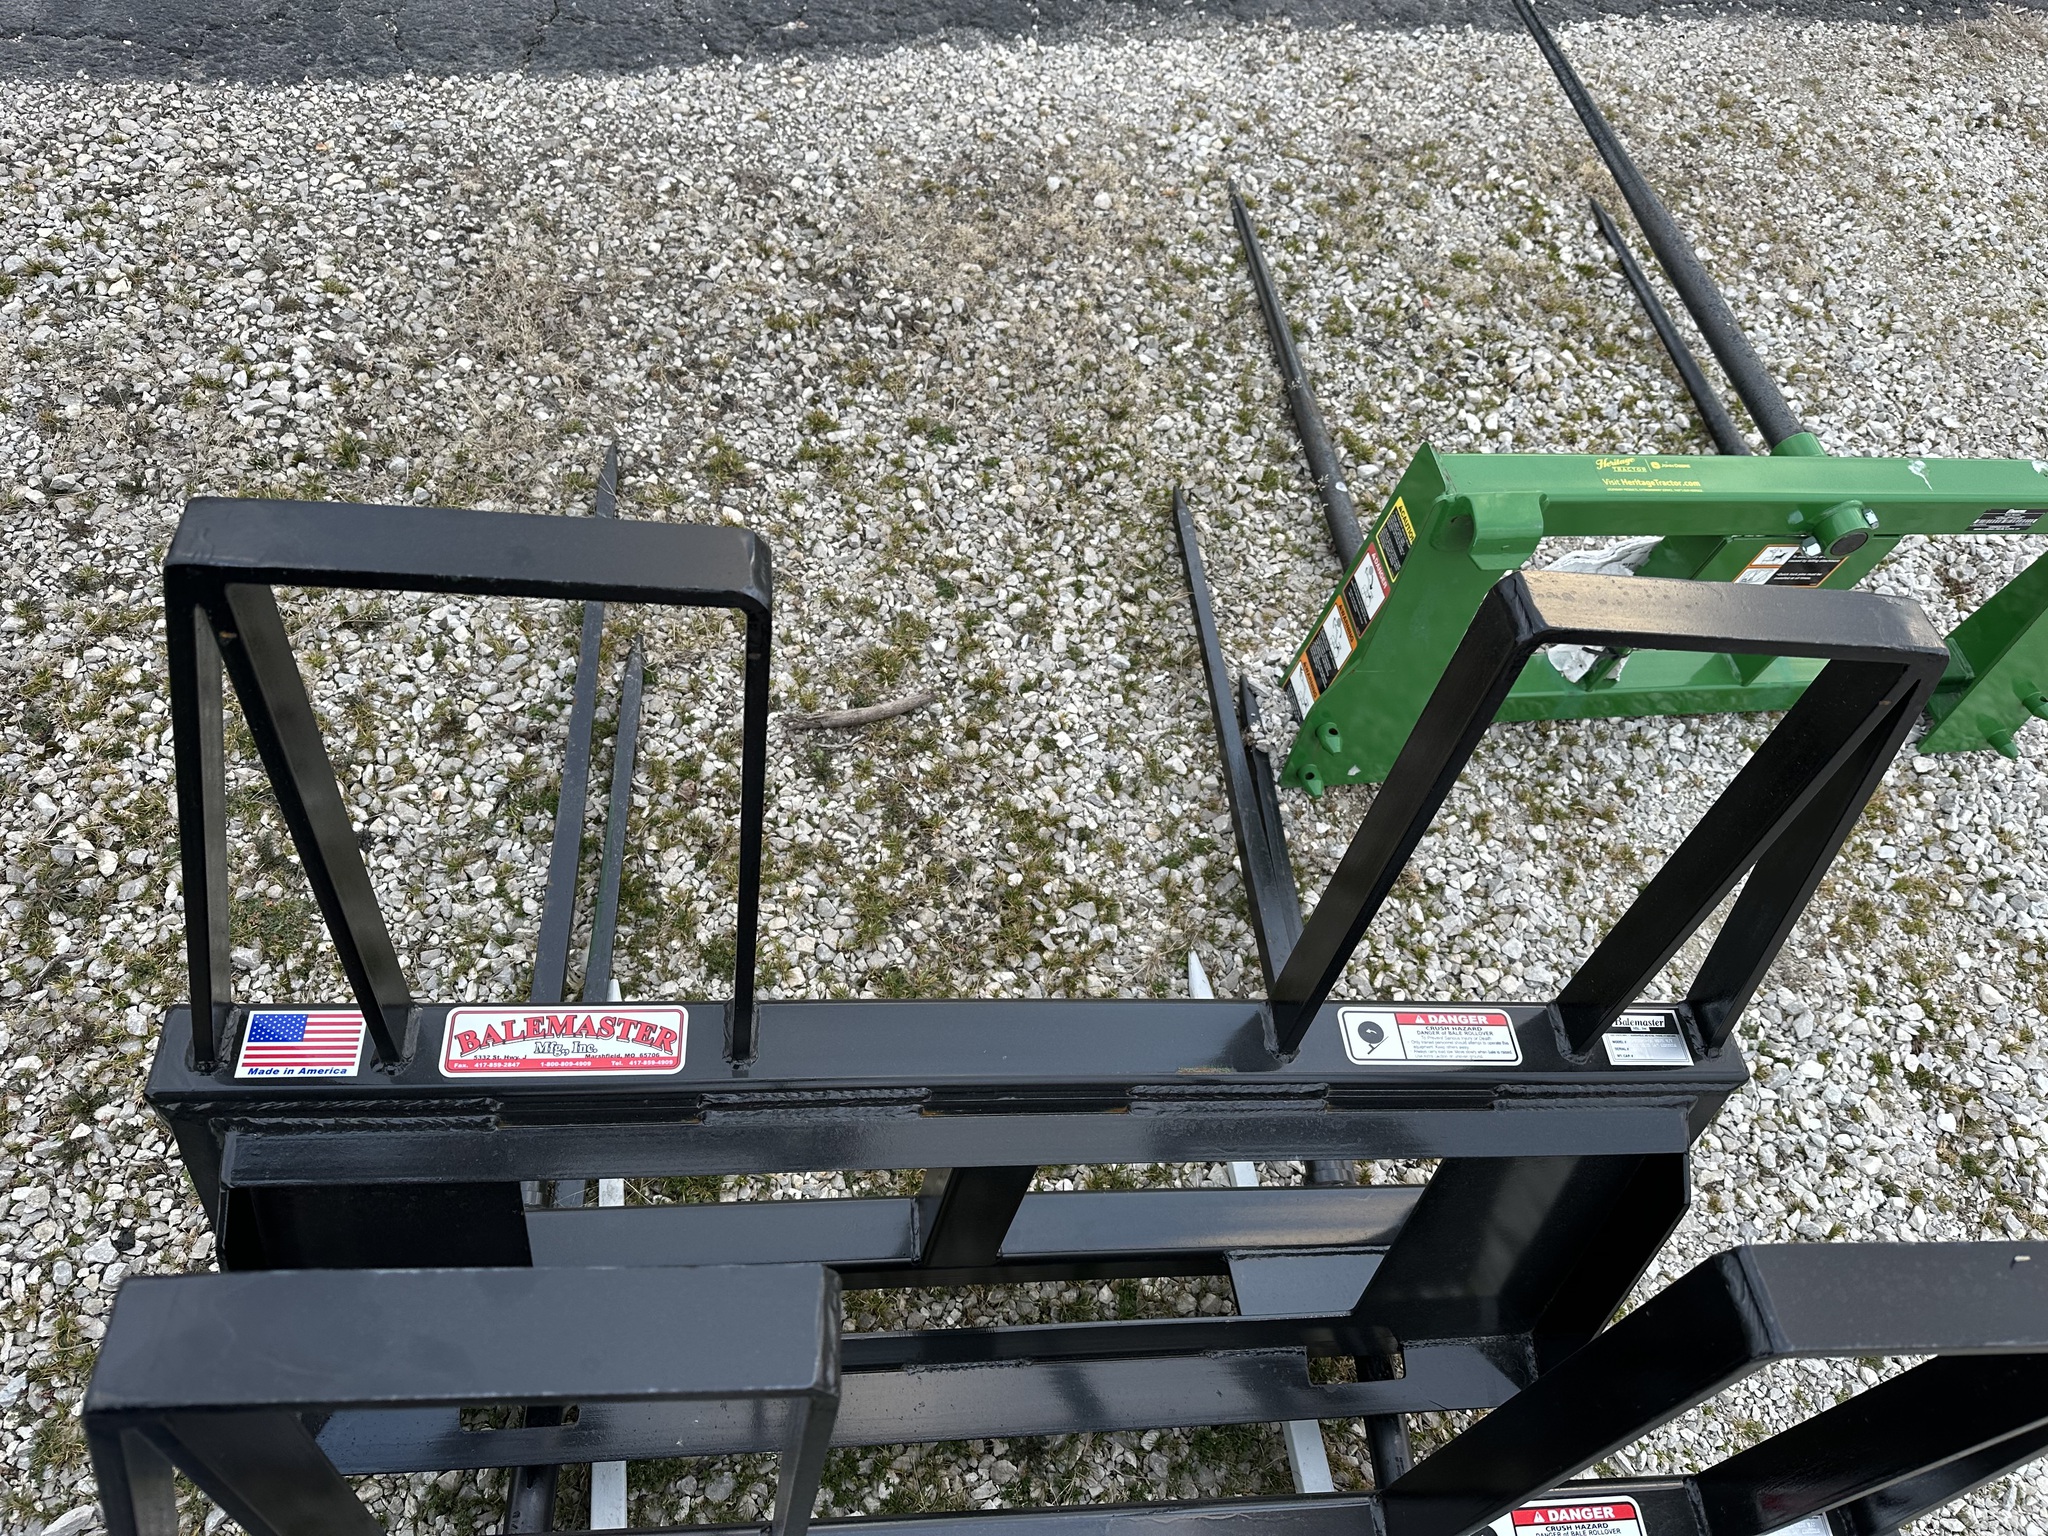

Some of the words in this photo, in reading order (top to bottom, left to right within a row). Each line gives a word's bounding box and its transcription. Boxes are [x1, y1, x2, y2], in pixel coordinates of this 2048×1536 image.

[1596, 458, 1635, 470] Heritage
[1621, 479, 1701, 487] HeritageTractor.com
[1374, 558, 1388, 589] DANGER
[1427, 1014, 1489, 1024] DANGER
[1614, 1016, 1664, 1026] Balemaster
[454, 1015, 678, 1057] BALEMASTER
[534, 1041, 570, 1056] Mfg.,
[572, 1041, 598, 1053] Inc.
[1547, 1506, 1615, 1521] DANGER
